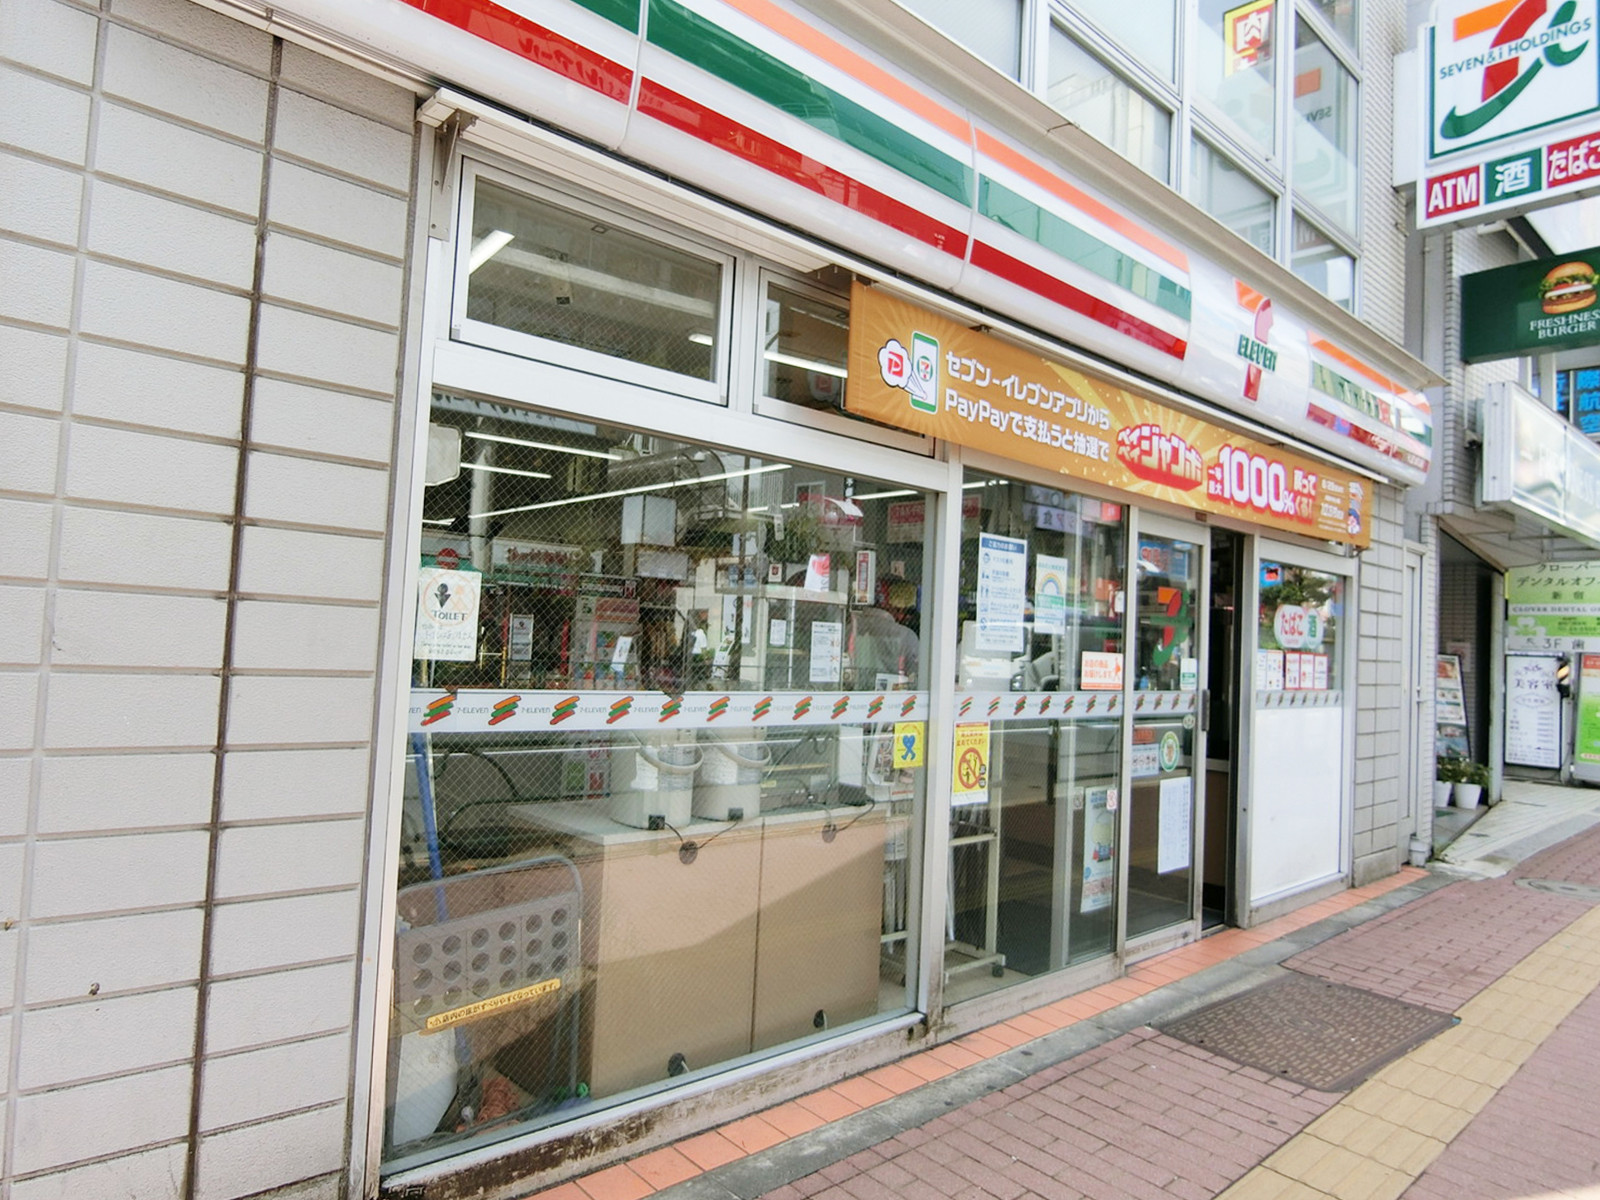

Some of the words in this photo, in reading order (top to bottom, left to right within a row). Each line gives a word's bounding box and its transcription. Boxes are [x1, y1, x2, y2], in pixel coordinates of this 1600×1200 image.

[1508, 18, 1592, 53] HOLDINGS
[1494, 158, 1531, 197] 酒
[1548, 139, 1600, 183] たばこ
[1428, 172, 1478, 213] ATM
[1538, 320, 1597, 339] BURGER
[944, 388, 1110, 463] PayPayで支払うと抽選で
[1219, 446, 1295, 515] 1000%
[431, 610, 467, 622] TOILET
[1280, 611, 1303, 636] たばこ
[1542, 638, 1561, 649] 3F
